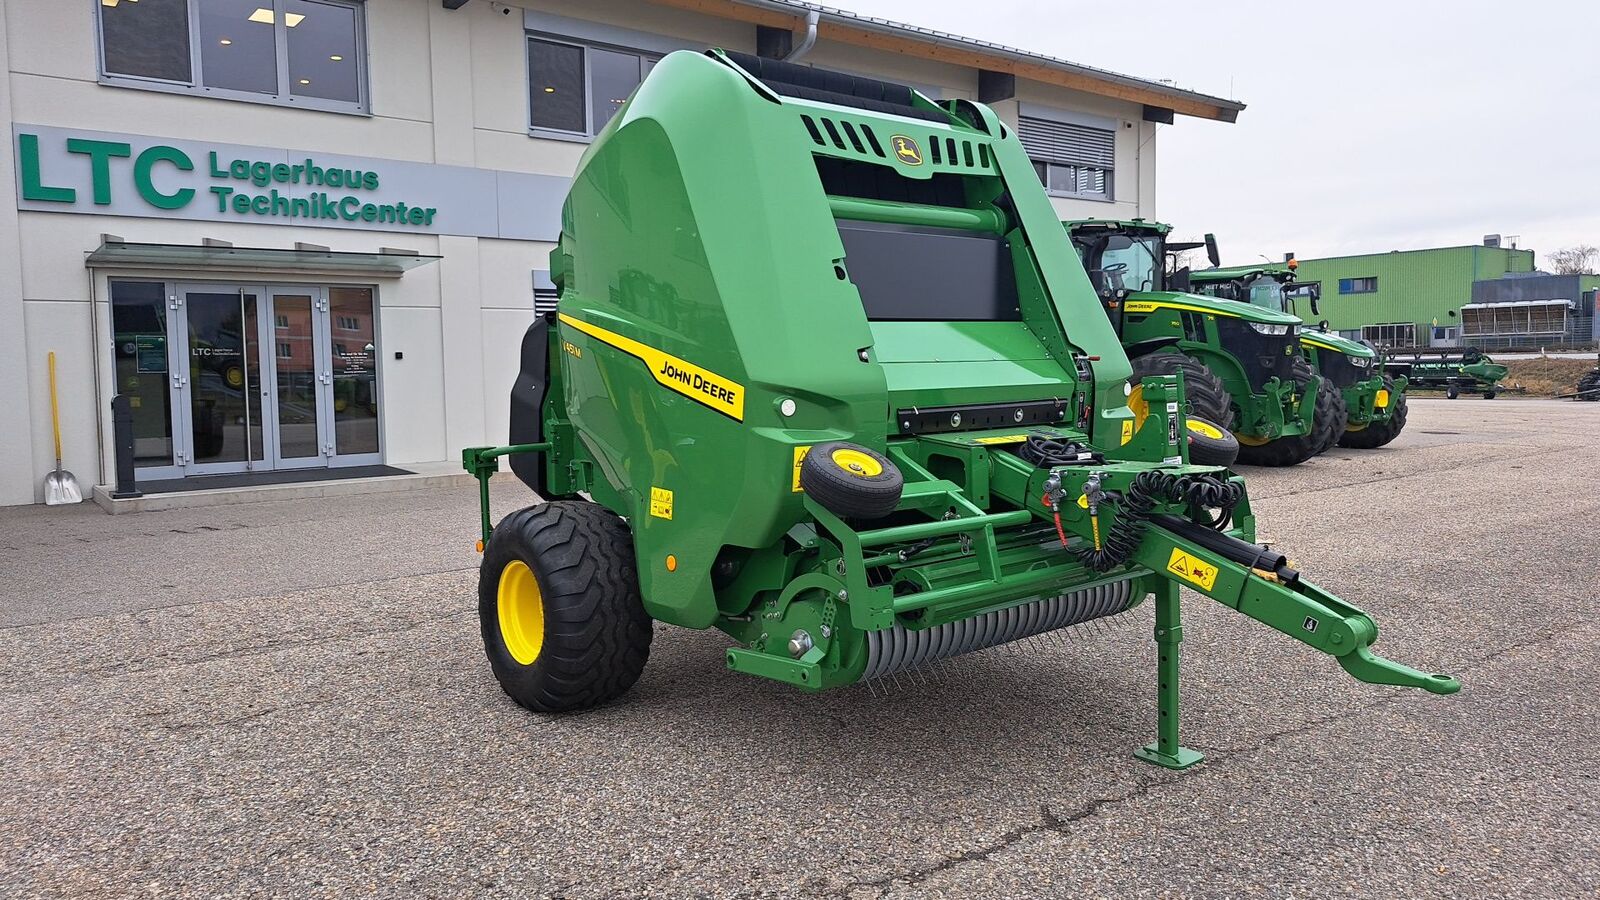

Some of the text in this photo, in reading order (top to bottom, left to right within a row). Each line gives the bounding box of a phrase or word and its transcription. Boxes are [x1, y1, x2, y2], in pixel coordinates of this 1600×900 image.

[19, 133, 196, 209] LTC
[209, 151, 379, 190] Lagerhaus
[210, 186, 437, 226] TechnikCenter
[192, 348, 211, 356] LTC
[660, 361, 735, 405] JOHN DEERE
